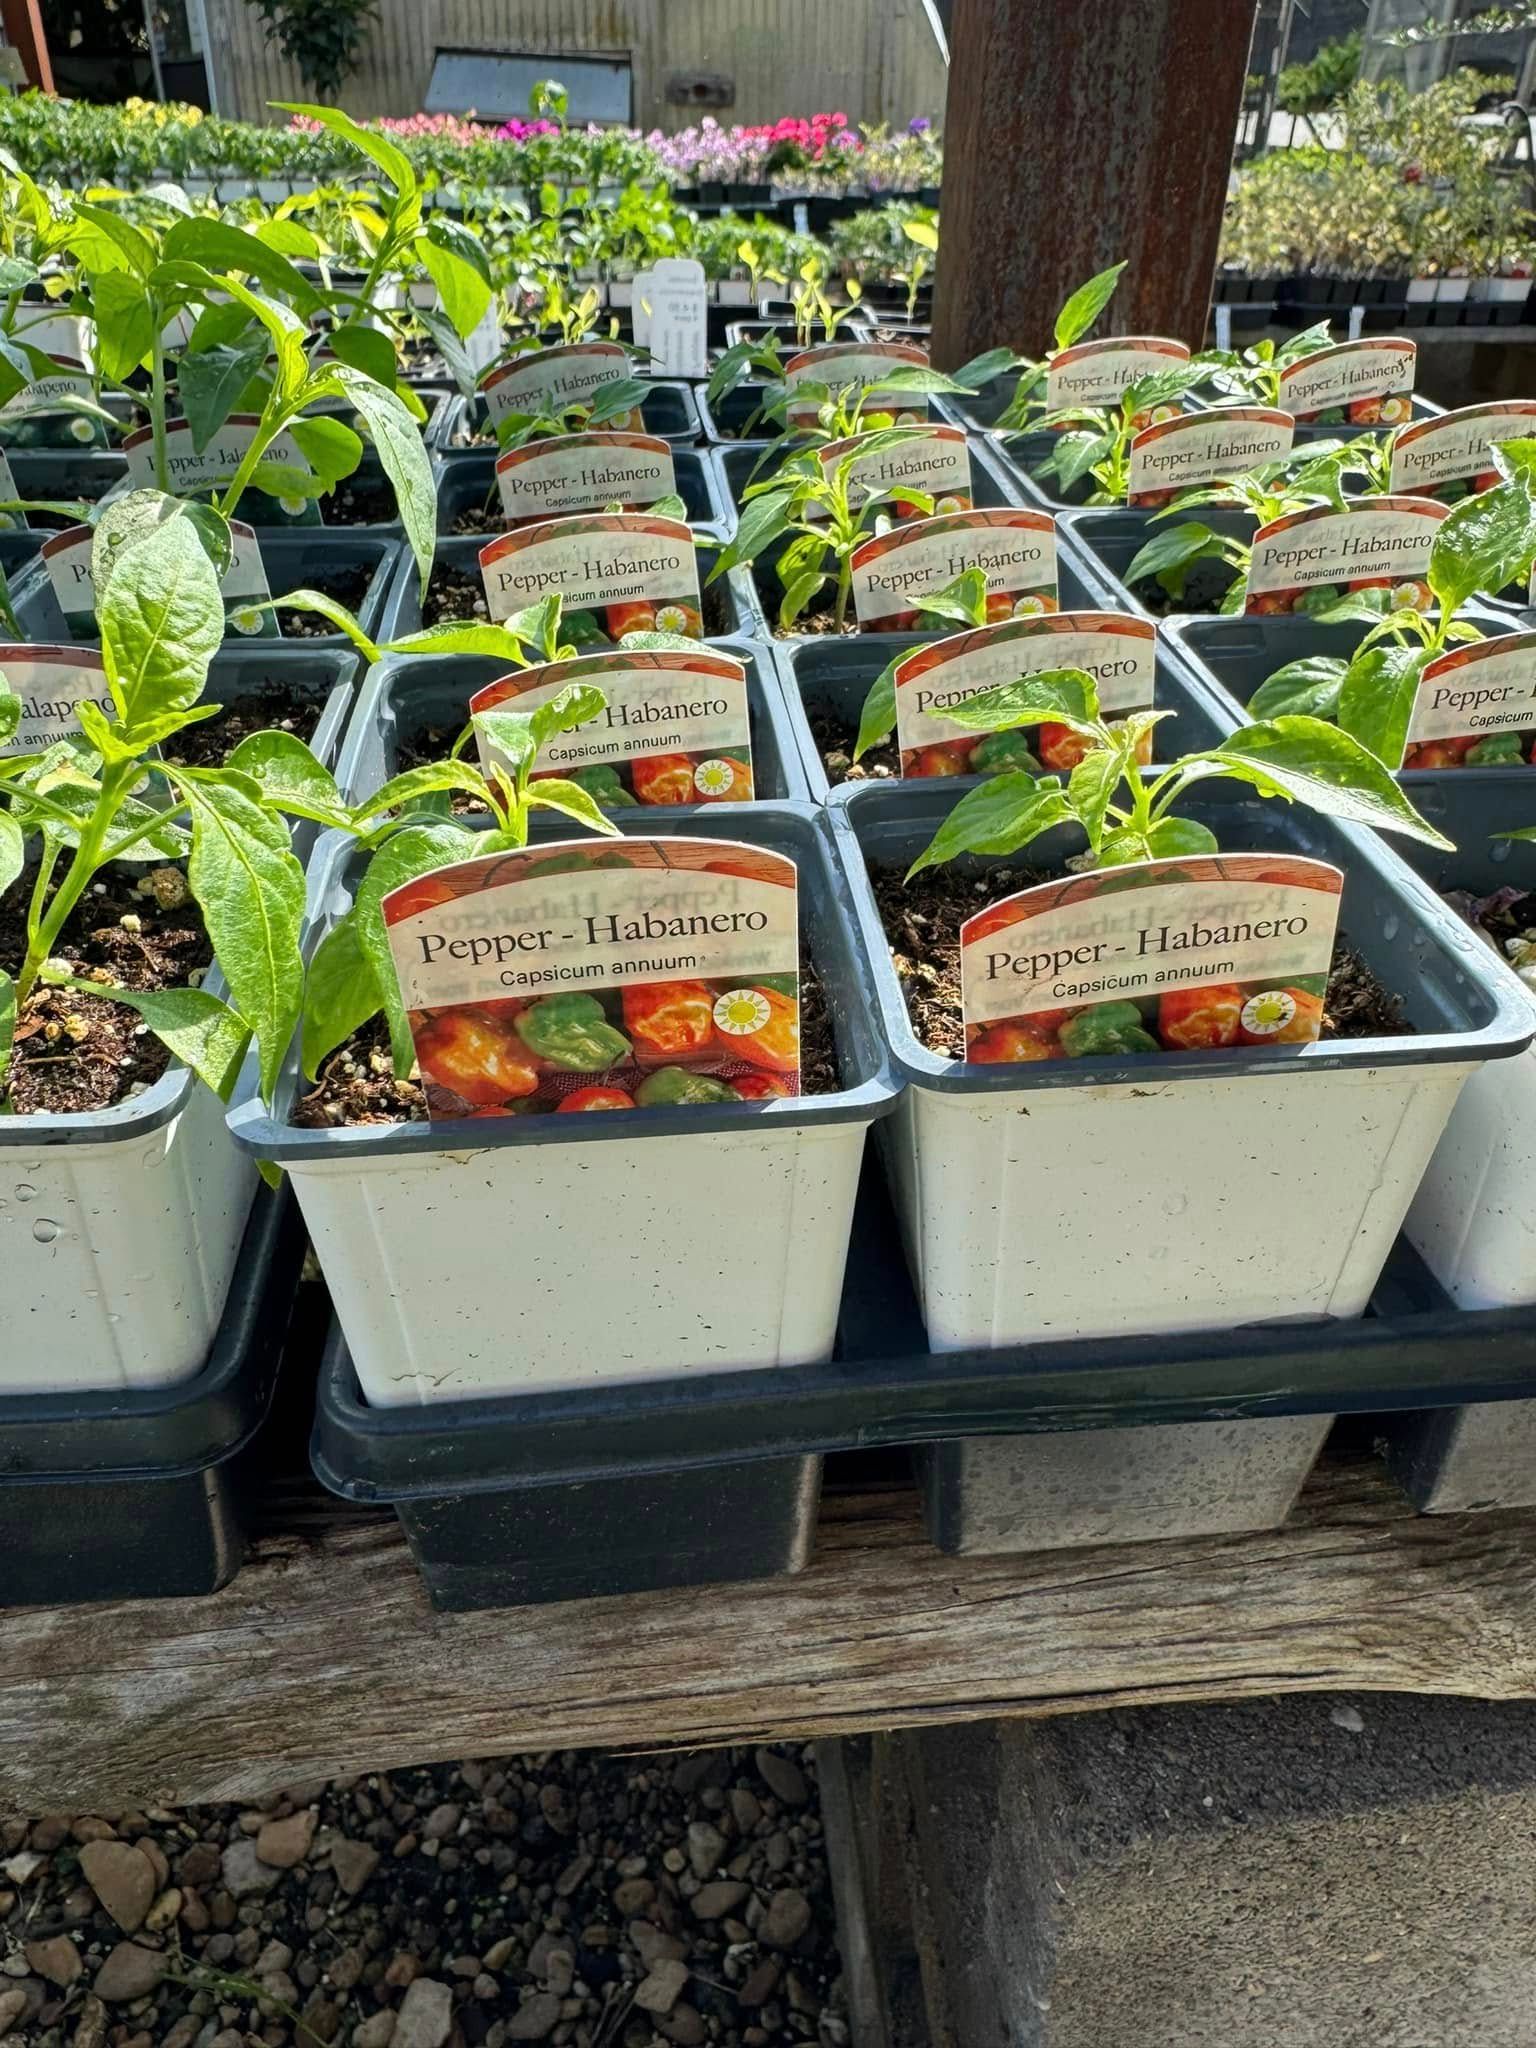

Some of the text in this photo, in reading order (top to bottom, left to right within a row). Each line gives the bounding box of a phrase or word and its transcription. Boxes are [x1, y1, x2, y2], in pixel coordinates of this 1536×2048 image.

[496, 386, 544, 409] Pepper
[553, 368, 620, 394] Habanero
[1057, 375, 1103, 392] Pepper
[1288, 380, 1332, 398] Pepper
[880, 455, 956, 480] Habanero
[1142, 450, 1194, 471] Pepper
[1207, 439, 1280, 460] Habanero
[1404, 447, 1456, 469] Pepper
[512, 476, 568, 495] Pepper
[581, 465, 660, 486] Habanero
[1169, 467, 1211, 482] Capsicum
[546, 493, 591, 508] Capsicum
[1264, 545, 1327, 568] Pepper
[1341, 535, 1432, 556] Habanero
[498, 567, 568, 593] Pepper
[583, 555, 680, 581] Habanero
[867, 567, 933, 593] Pepper
[949, 546, 1042, 576] Habanero
[1294, 560, 1391, 581] Capsicum annuum
[599, 584, 645, 599] annuum
[1431, 685, 1514, 712] Pepper
[605, 698, 728, 729] Habanero
[1469, 711, 1533, 728] Capsicum
[549, 733, 682, 761] Capsicum annuum
[416, 928, 552, 966] Pepper
[584, 910, 768, 946] Habanero
[985, 943, 1107, 980] Pepper
[1136, 916, 1308, 956] Habanero
[500, 962, 605, 988] Capsicum
[612, 953, 697, 975] annuum
[1052, 960, 1235, 999] Capsicum annuum
